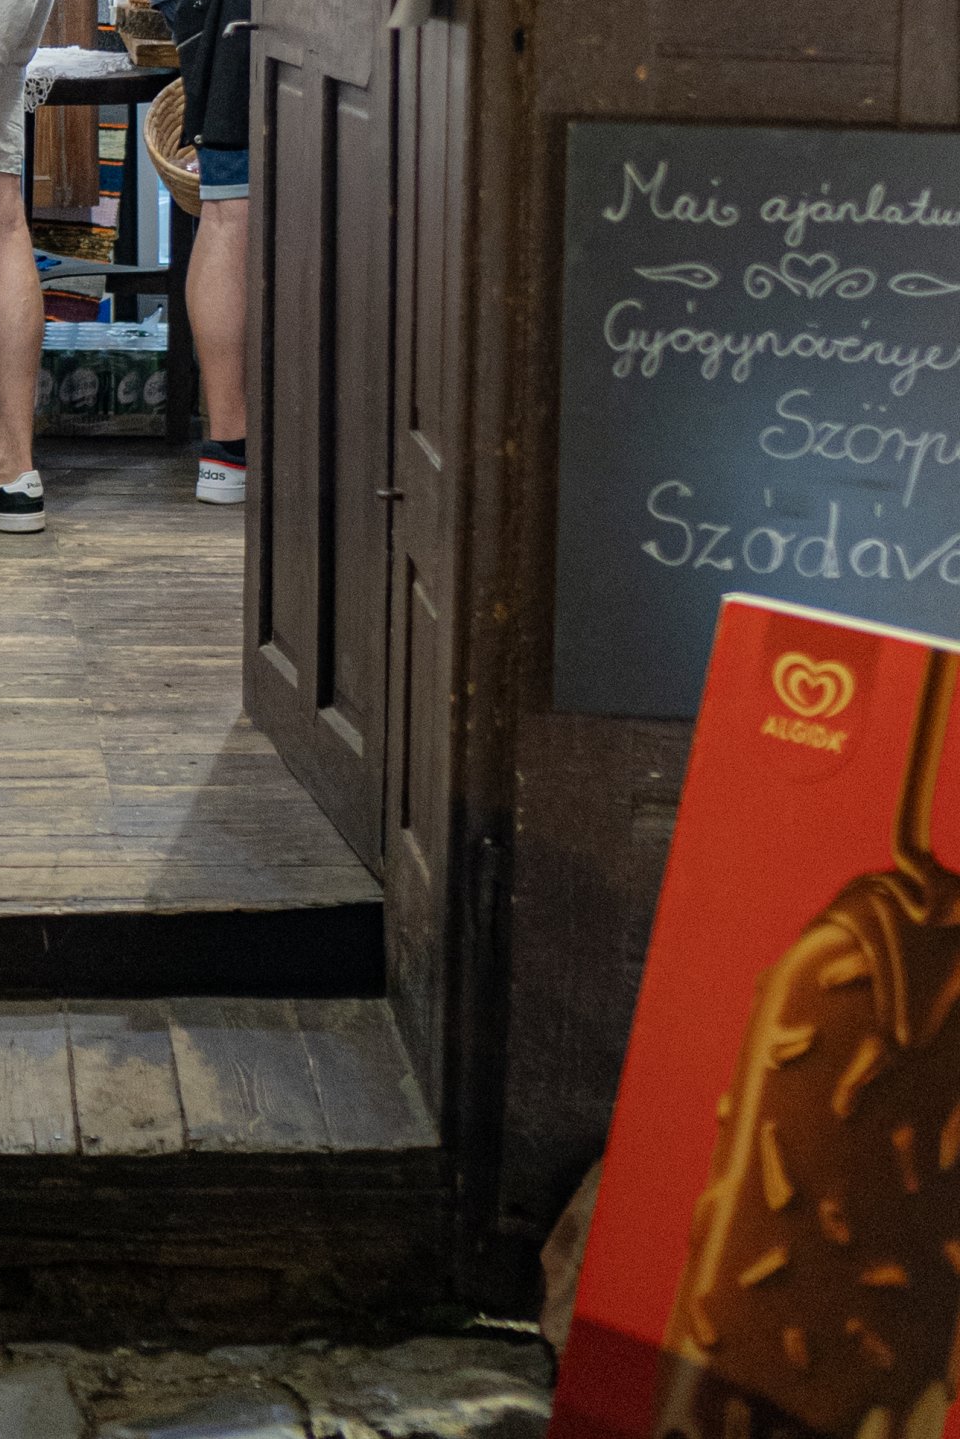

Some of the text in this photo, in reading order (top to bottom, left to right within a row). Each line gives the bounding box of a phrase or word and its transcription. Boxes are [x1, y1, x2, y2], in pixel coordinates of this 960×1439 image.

[602, 159, 739, 229] Mai
[602, 299, 960, 396] Gyógynövénye
[759, 388, 960, 509] Szörp
